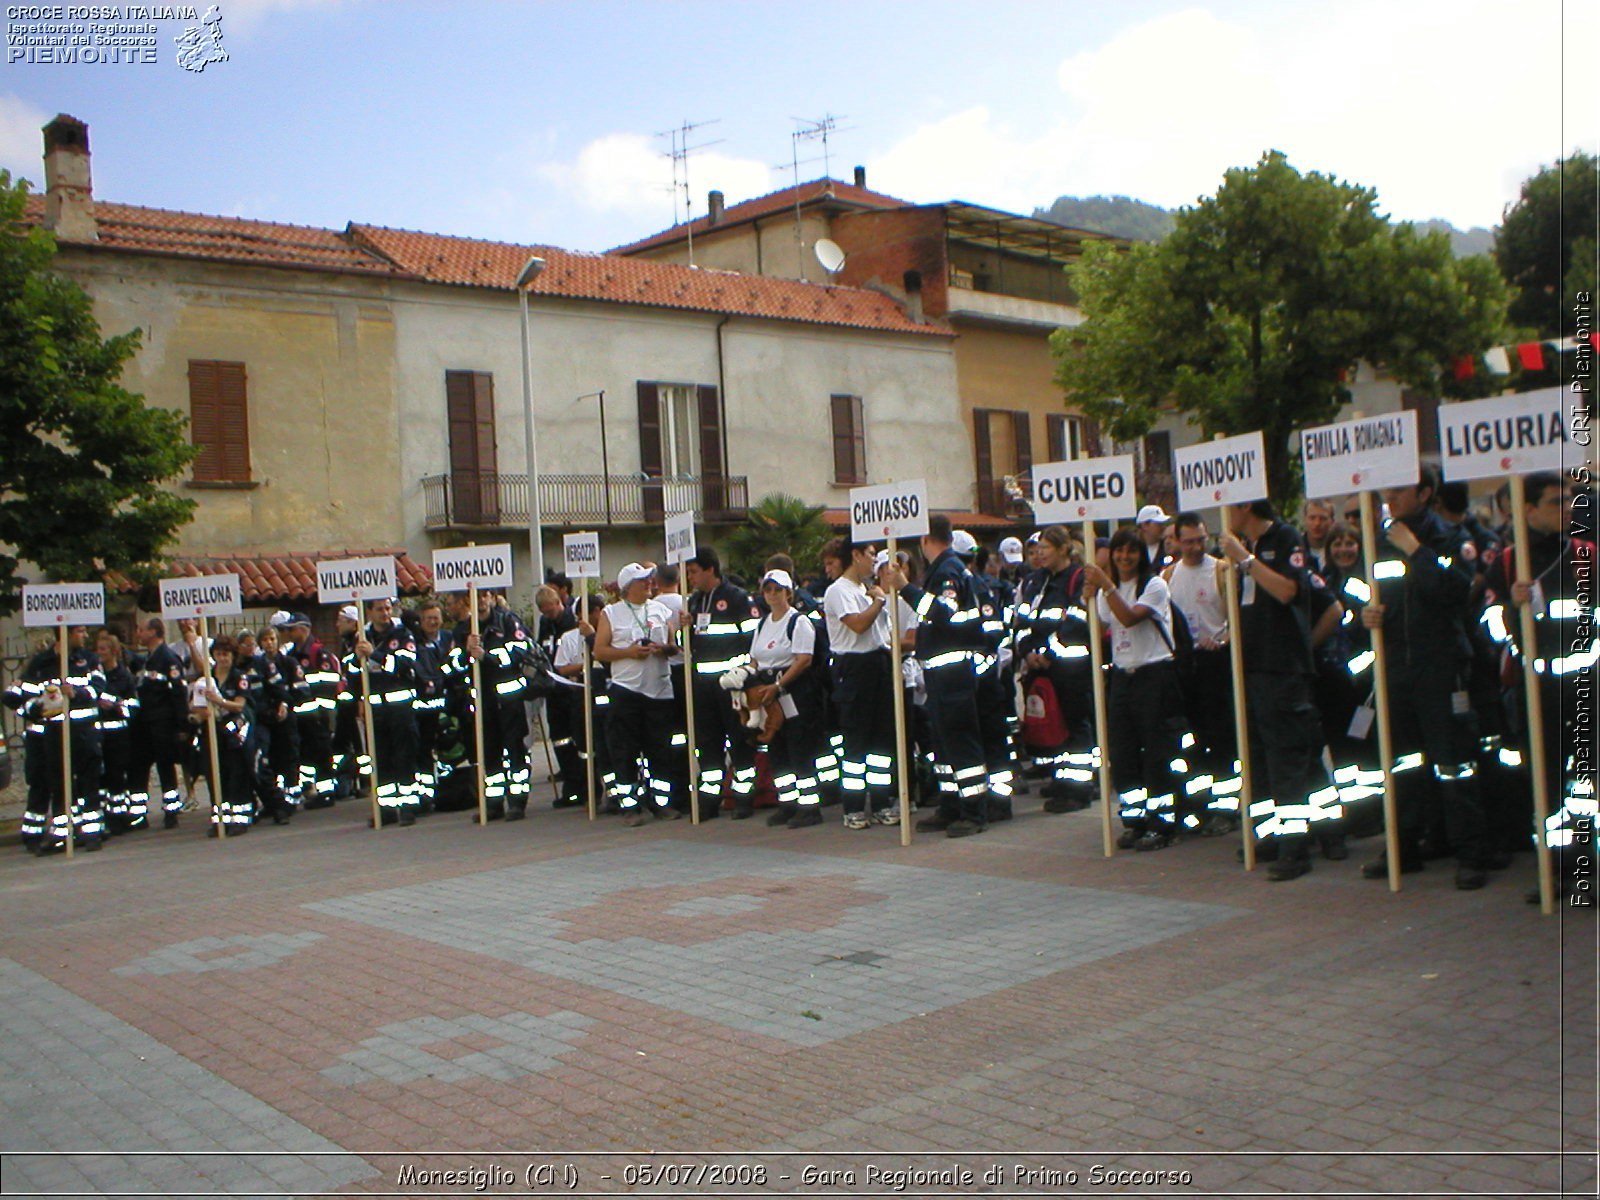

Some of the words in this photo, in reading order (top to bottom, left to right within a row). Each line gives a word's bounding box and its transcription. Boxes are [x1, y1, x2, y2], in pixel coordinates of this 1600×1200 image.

[1306, 427, 1351, 460] EMILIA
[1396, 418, 1403, 445] 2
[1447, 411, 1568, 457] LIGURIA
[1180, 450, 1255, 490] MONDOVI'
[1038, 472, 1125, 504] CUNEO
[853, 494, 919, 525] CHIVASSO
[320, 568, 389, 591] VILLANOVA
[436, 557, 504, 581] MONCALVO
[26, 592, 103, 612] BORGOMANERO
[163, 585, 233, 608] GRAVELLONA
